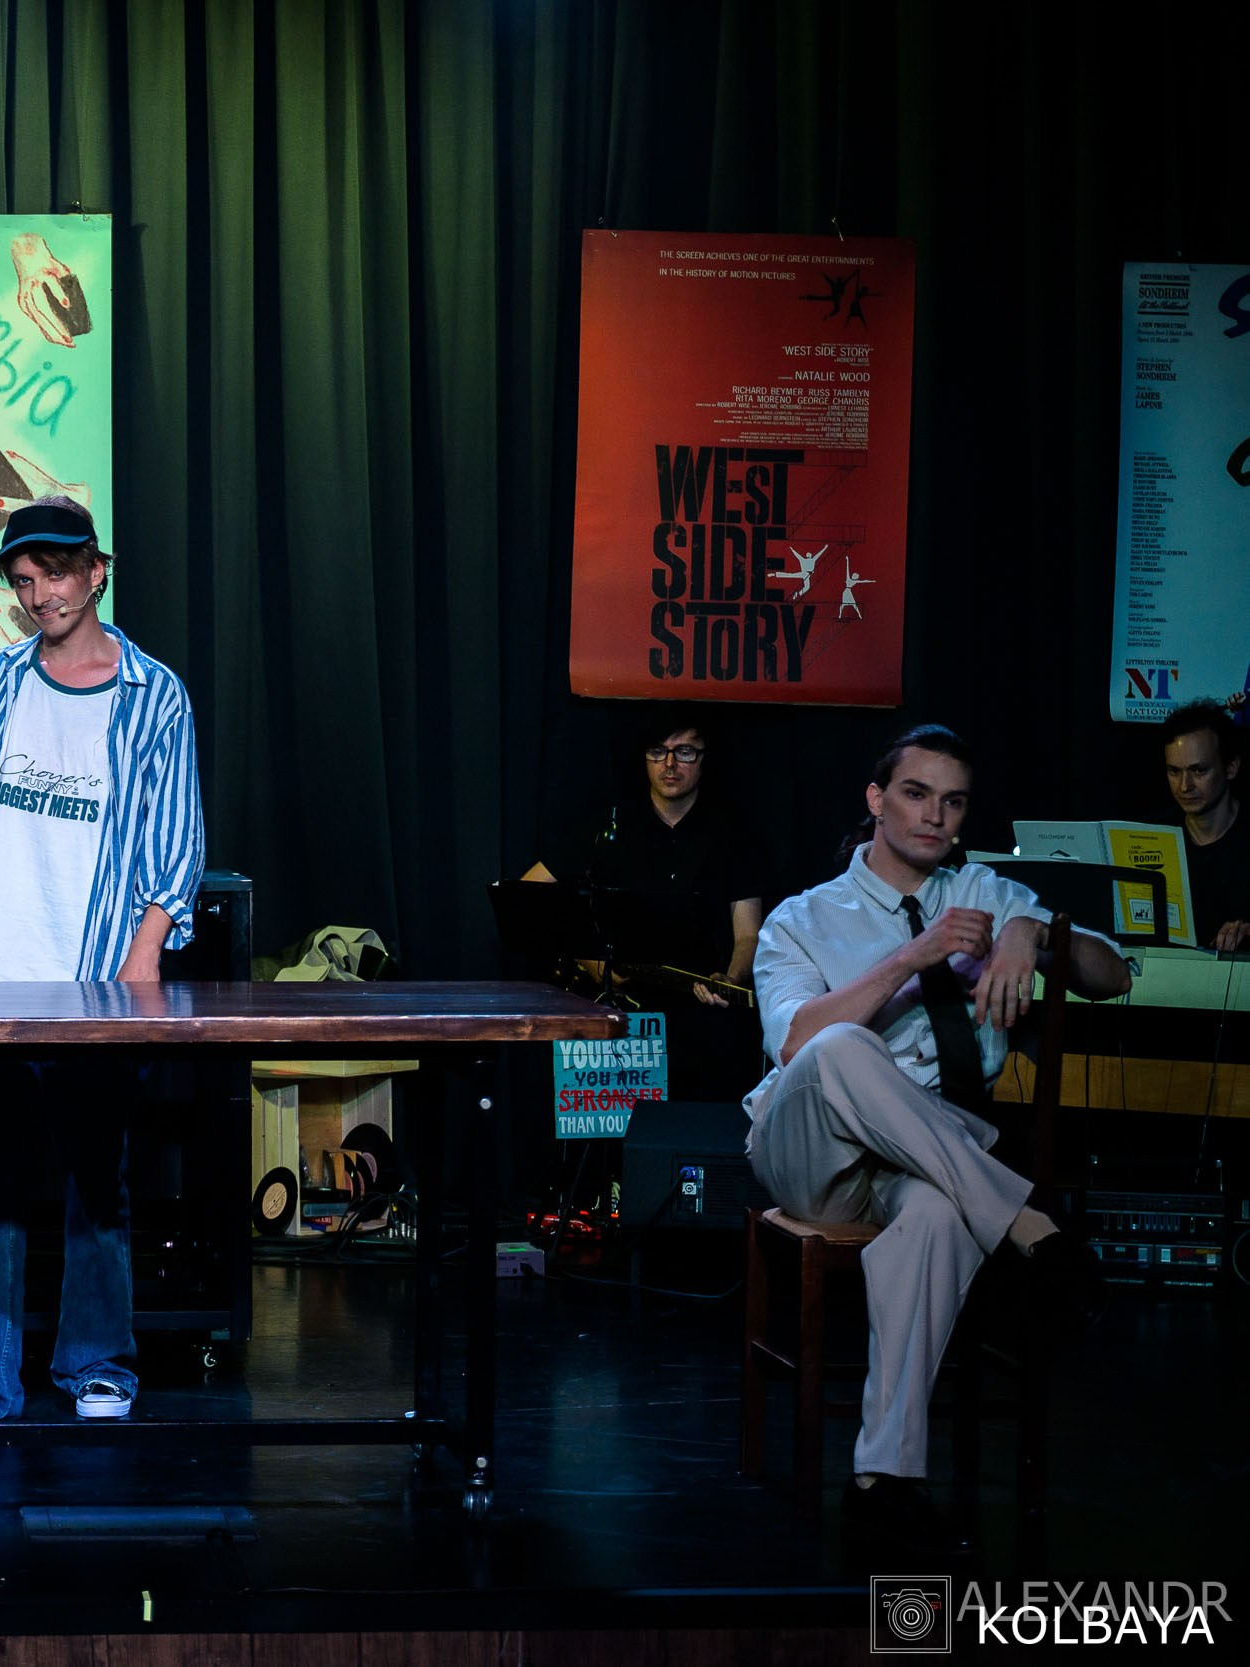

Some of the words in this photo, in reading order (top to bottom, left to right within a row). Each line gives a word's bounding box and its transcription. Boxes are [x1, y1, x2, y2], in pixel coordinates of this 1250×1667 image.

[660, 250, 674, 259] THE
[676, 251, 704, 260] SCREEN
[706, 252, 741, 261] ACHIEVES
[743, 253, 759, 261] ONE
[760, 253, 770, 261] OF
[772, 254, 785, 262] THE
[787, 254, 810, 263] GREAT
[812, 255, 874, 265] ENTERTAINMENTS
[659, 268, 667, 276] IN
[669, 268, 683, 276] THE
[686, 269, 716, 278] HISTORY
[718, 270, 728, 278] OF
[730, 270, 758, 279] MOTION
[761, 272, 796, 280] PICTURES
[1139, 287, 1189, 300] SONDHEIM
[815, 346, 837, 356] SIDE
[1136, 363, 1172, 371] STEPHEN
[795, 371, 835, 382] NATALIE
[840, 372, 870, 382] WOOD
[1136, 372, 1176, 381] SONDHEIM
[732, 386, 767, 394] RICHARD
[771, 387, 803, 396] BEYMER
[809, 388, 830, 397] RUSS
[833, 389, 870, 397] TAMBLYN
[1136, 392, 1160, 400] JAMES
[757, 395, 792, 404] MORENO
[797, 397, 829, 405] GEORGE
[832, 398, 870, 406] CHAKIRIS
[1136, 401, 1162, 409] LAPINE
[655, 445, 804, 524] WEST
[652, 522, 786, 602] SIDE
[649, 601, 816, 682] STORY
[1125, 668, 1178, 699] NT
[1126, 707, 1175, 715] NATIONA
[18, 775, 72, 795] FUNNY
[48, 794, 99, 823] MEETS
[559, 1039, 663, 1070] YOURSELF
[574, 1071, 610, 1087] YOU
[614, 1070, 651, 1086] ARE
[558, 1088, 663, 1112] STRONGER
[559, 1116, 595, 1133] THAN
[599, 1115, 623, 1132] YOU
